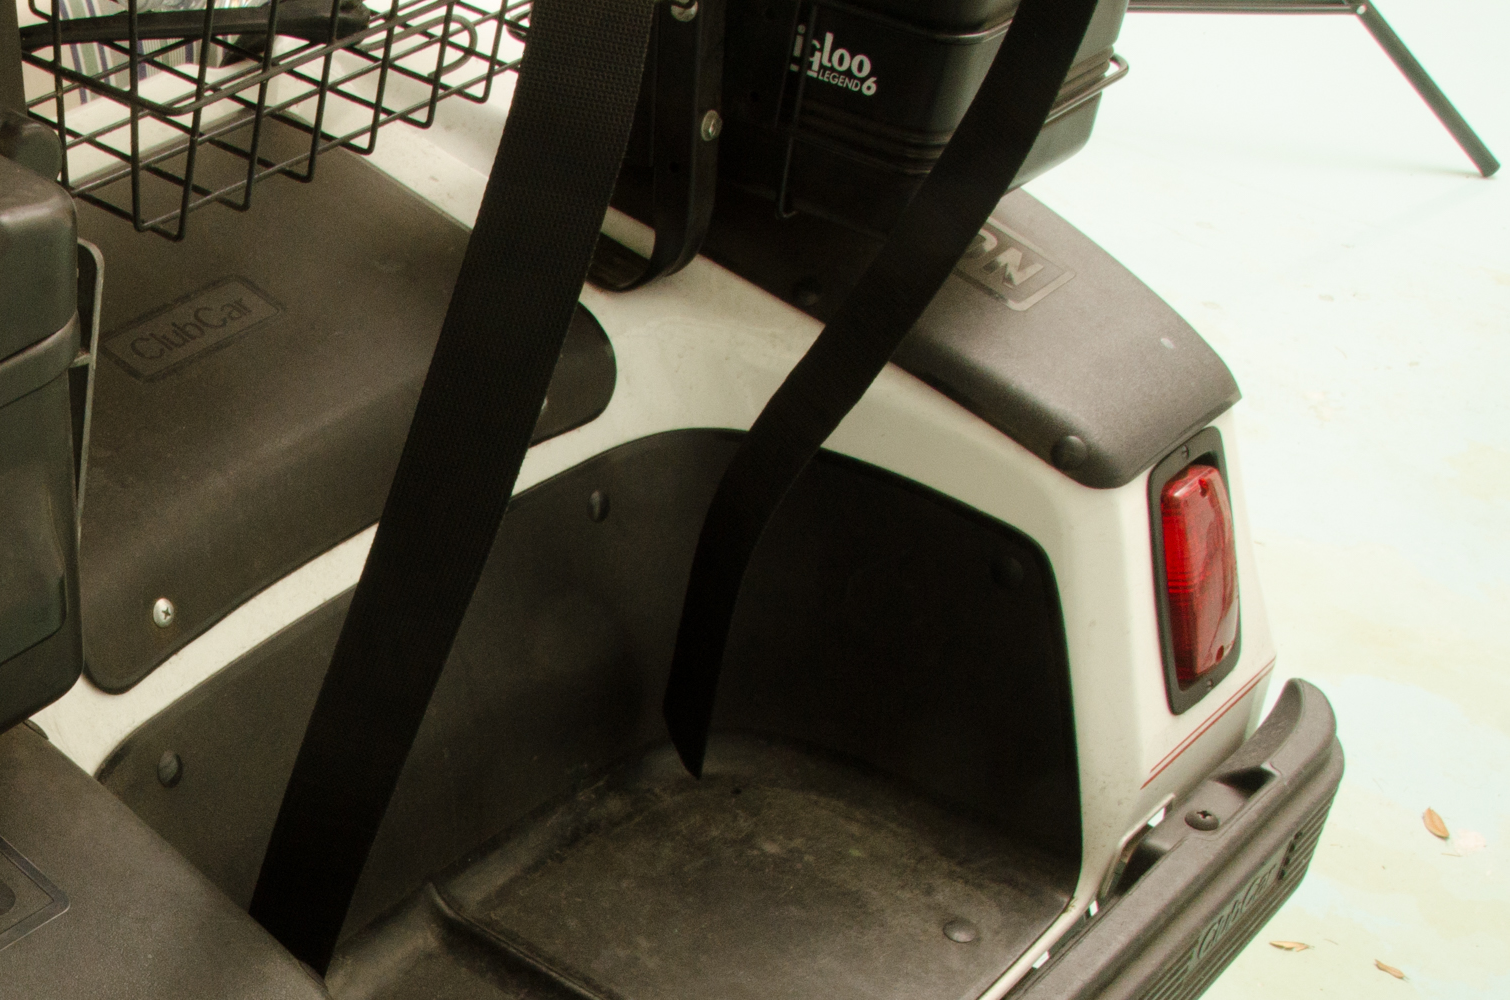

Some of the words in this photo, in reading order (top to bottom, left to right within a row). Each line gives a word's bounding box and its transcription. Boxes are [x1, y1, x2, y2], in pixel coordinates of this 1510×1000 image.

[791, 23, 872, 78] igloo
[817, 68, 861, 92] LEGEND
[861, 76, 878, 96] 6
[130, 298, 253, 361] ClubCar
